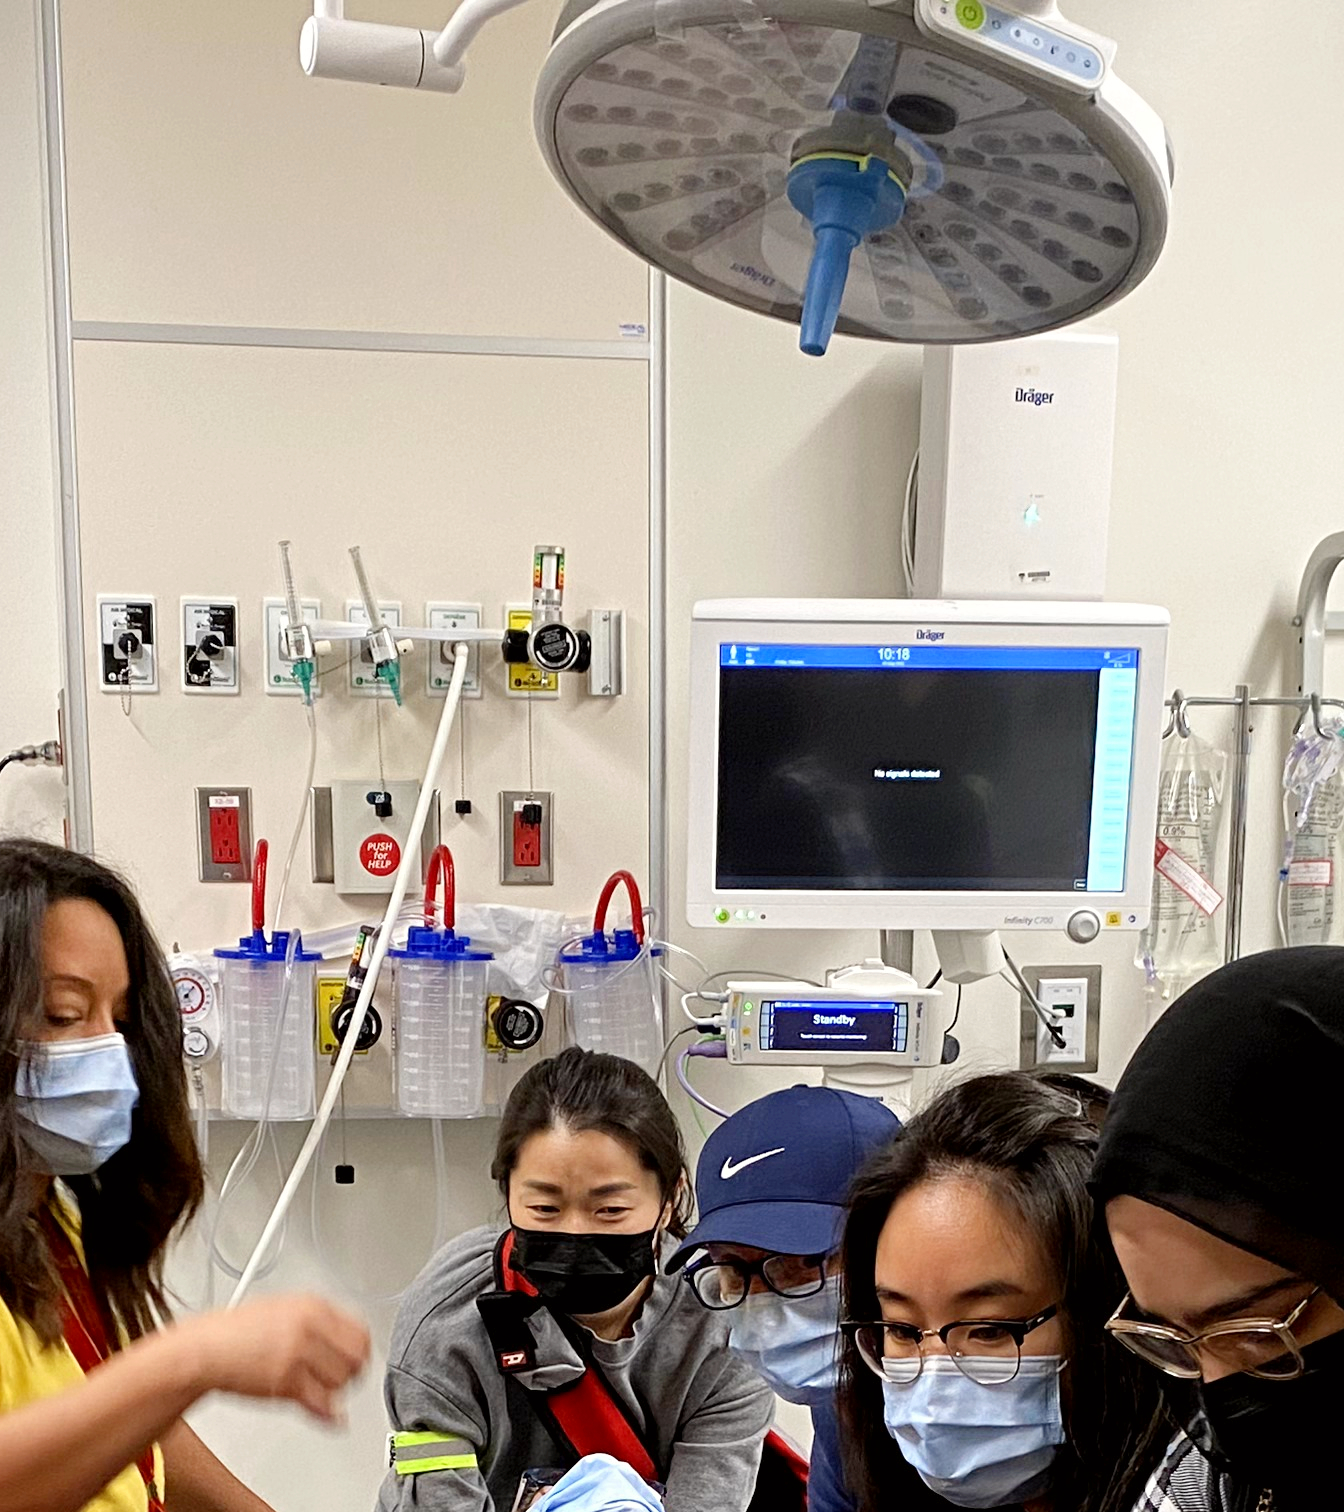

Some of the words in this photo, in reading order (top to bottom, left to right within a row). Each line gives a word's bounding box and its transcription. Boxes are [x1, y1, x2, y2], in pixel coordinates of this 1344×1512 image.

[1015, 387, 1054, 406] Dräger
[916, 629, 945, 641] Dräger
[877, 647, 911, 661] 10:18
[367, 842, 392, 851] PUSH
[373, 851, 388, 860] for
[368, 860, 392, 869] HELP
[1004, 916, 1033, 926] Infinity
[813, 1014, 856, 1026] Standby
